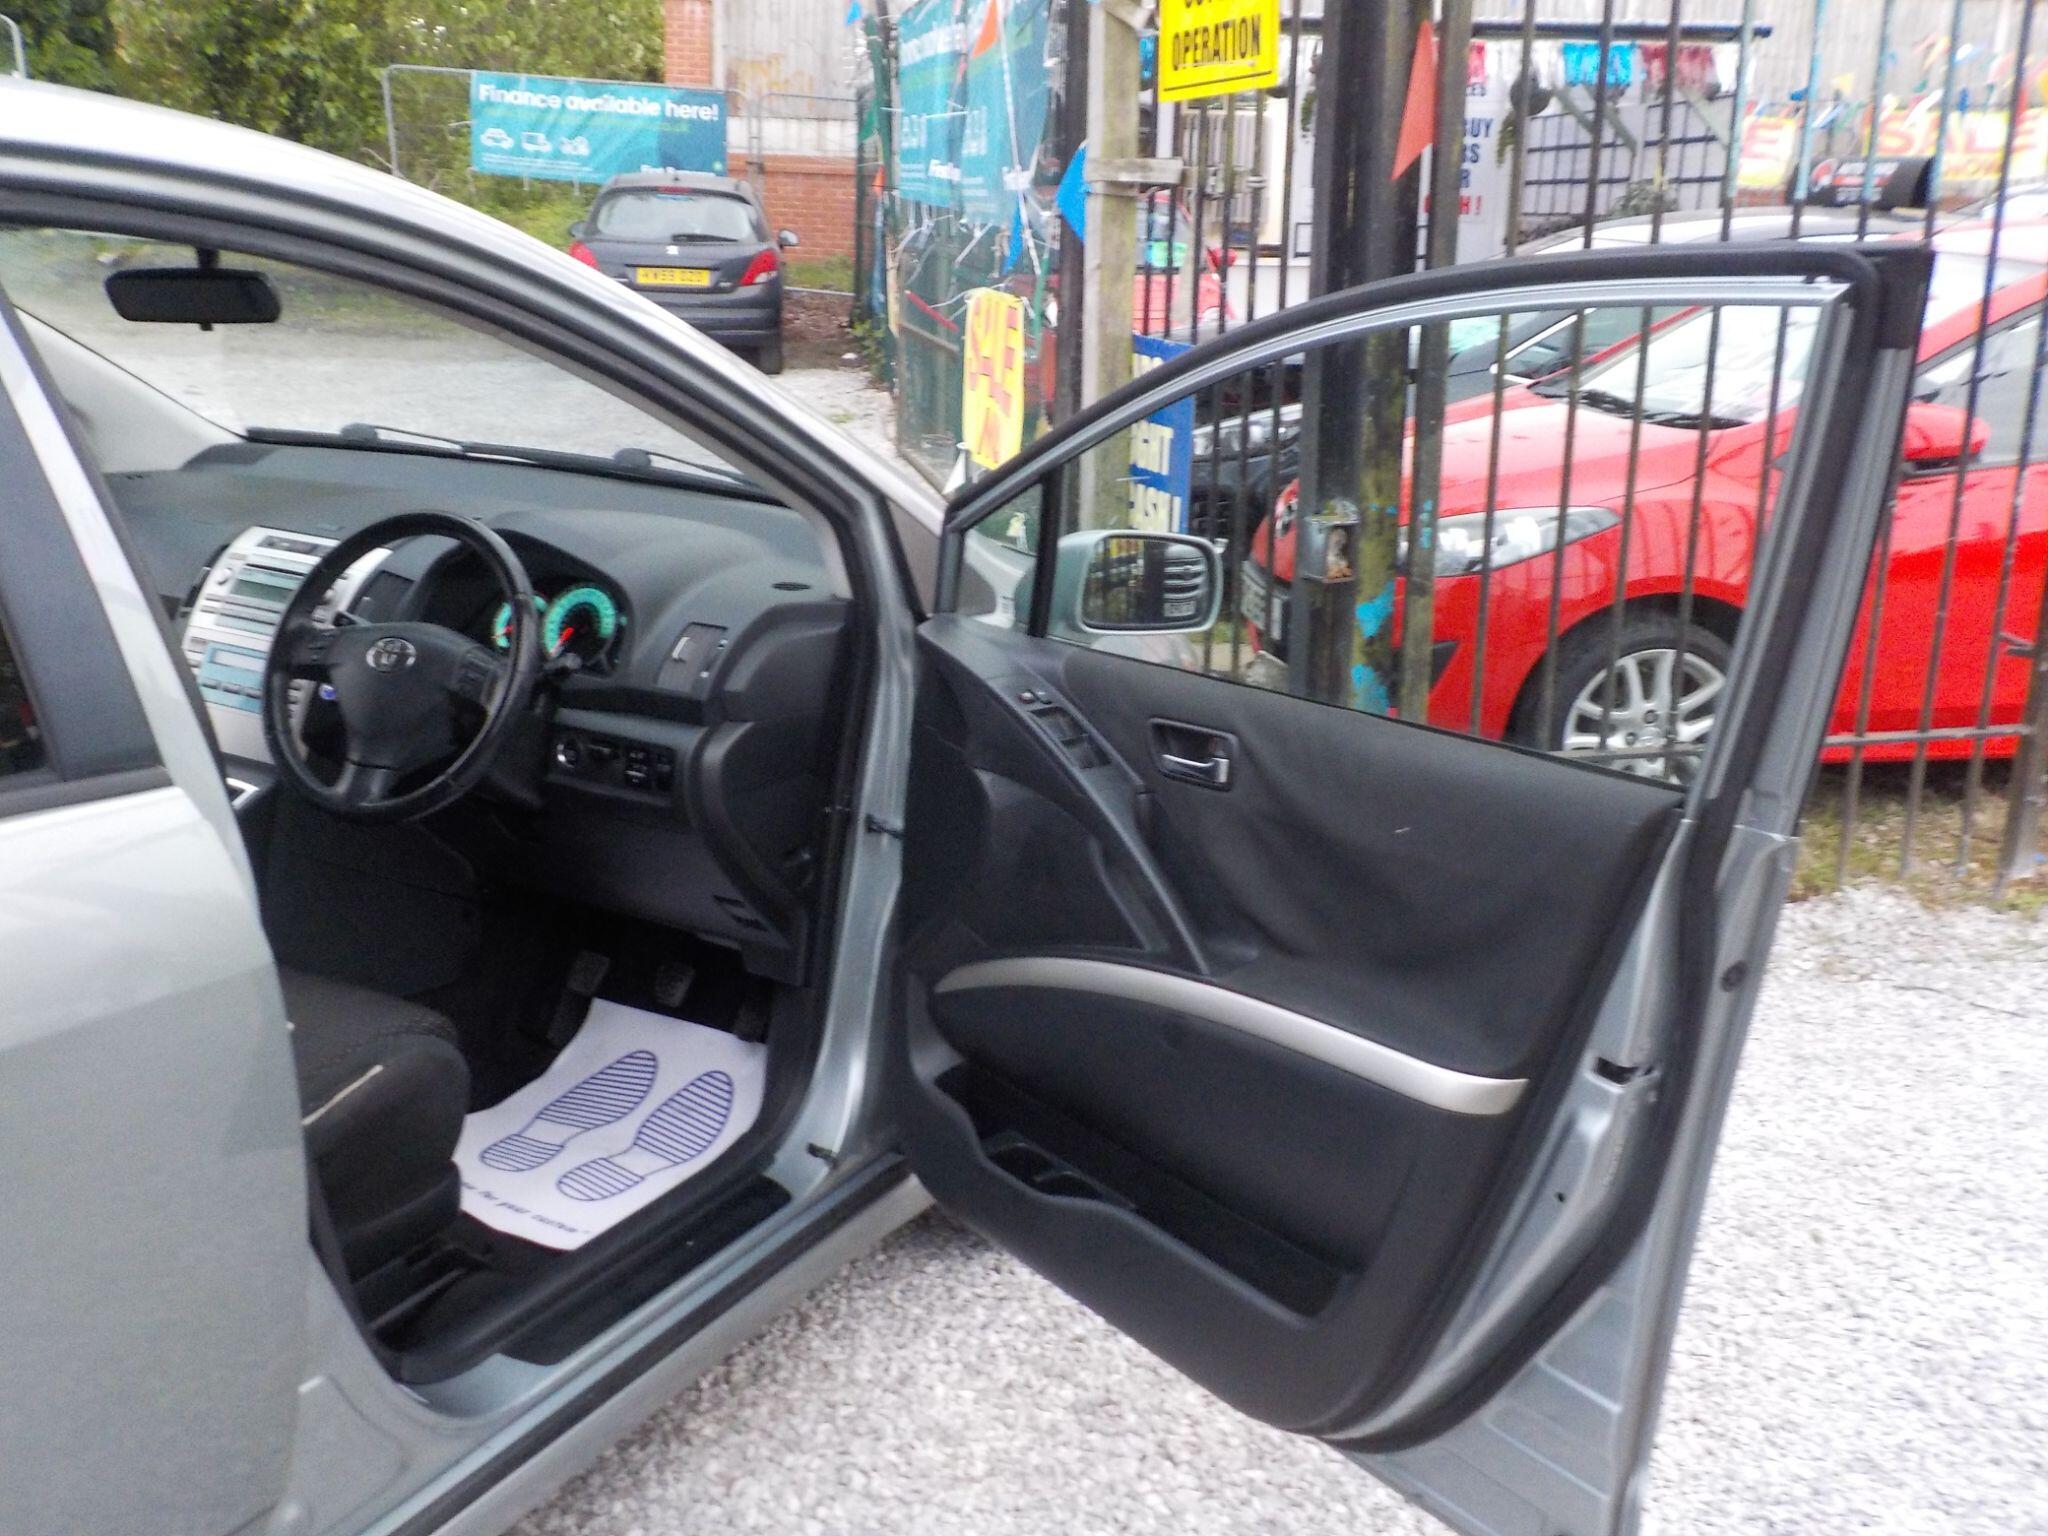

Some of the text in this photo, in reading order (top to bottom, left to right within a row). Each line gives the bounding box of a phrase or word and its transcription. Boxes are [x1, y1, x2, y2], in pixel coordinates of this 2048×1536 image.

[1172, 13, 1261, 72] OPERATION
[478, 84, 562, 110] Finance
[564, 94, 663, 117] available
[664, 100, 719, 121] here!
